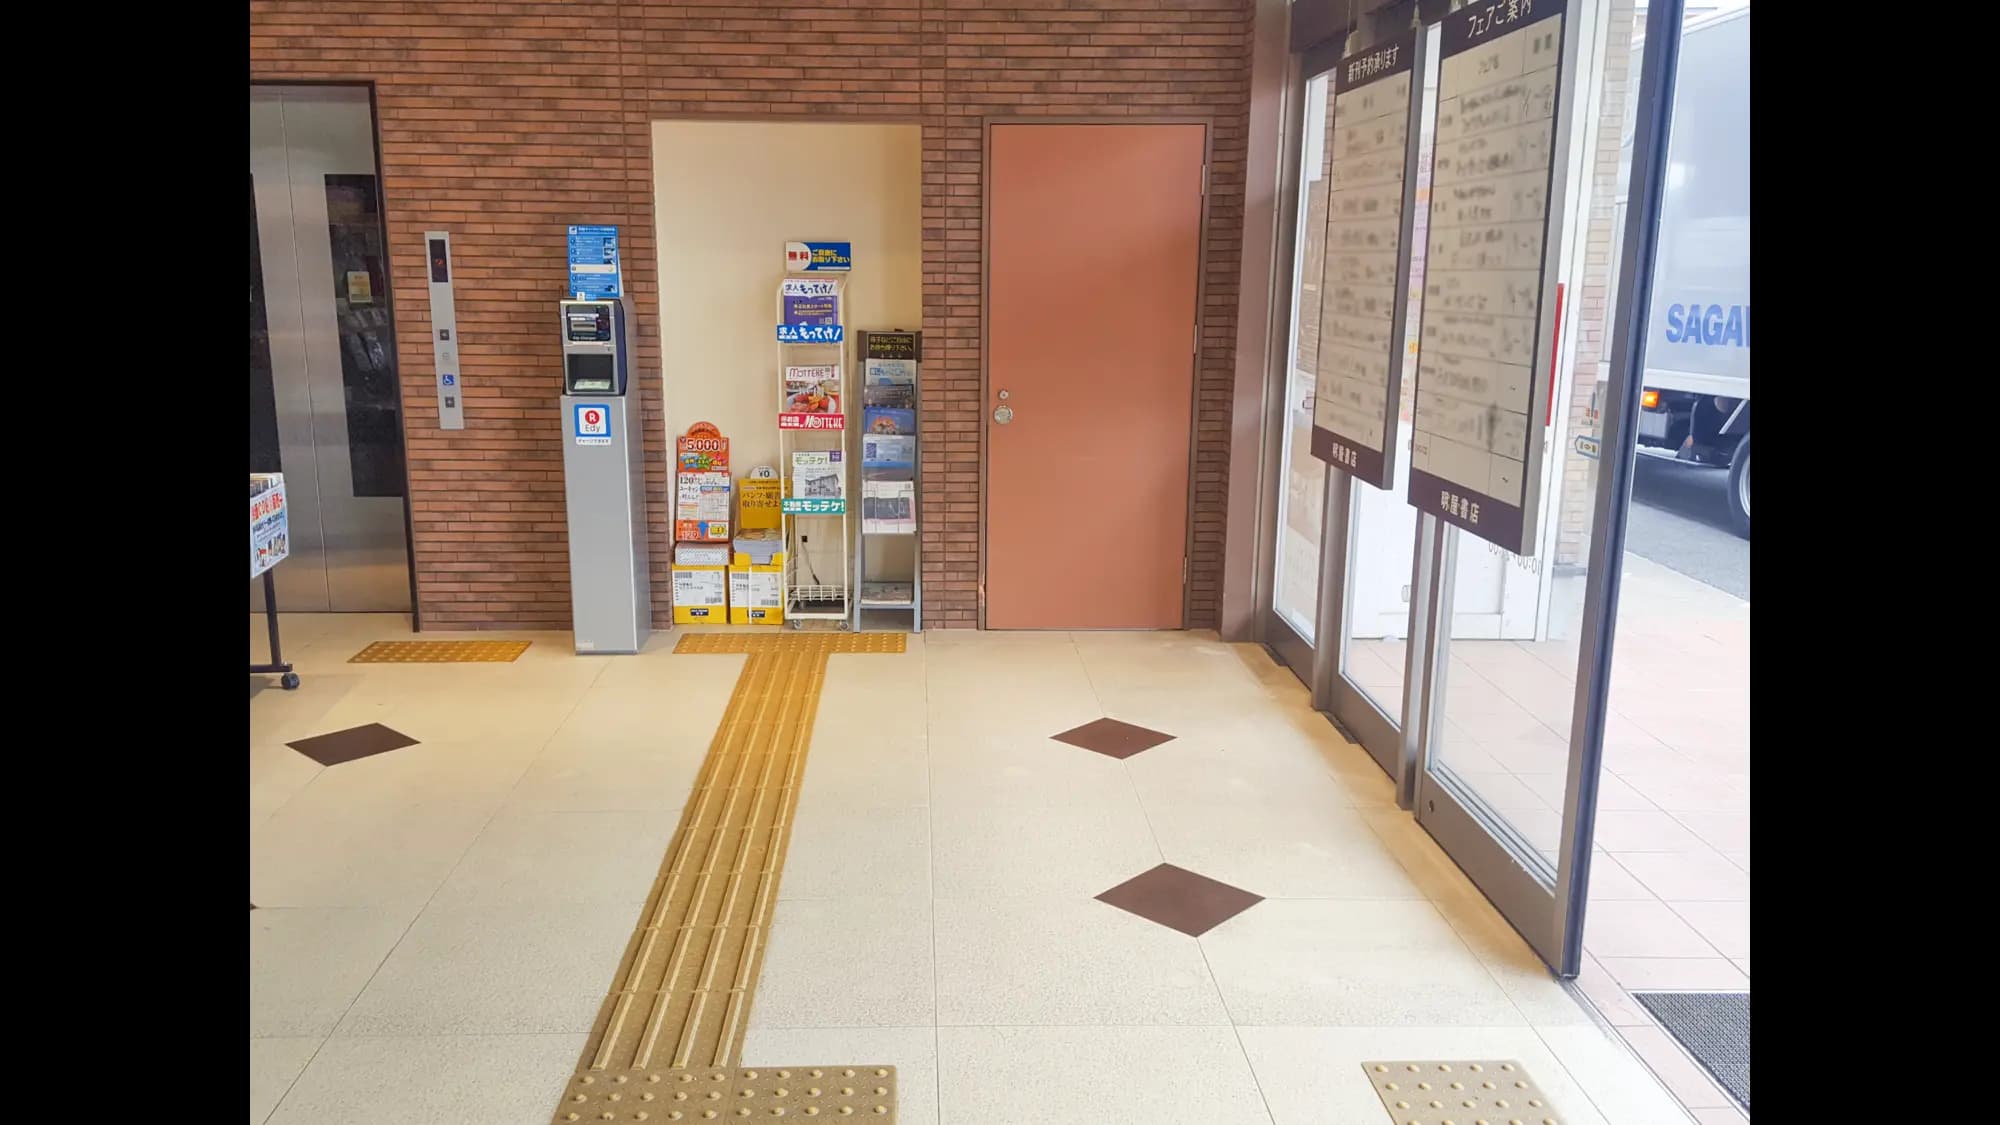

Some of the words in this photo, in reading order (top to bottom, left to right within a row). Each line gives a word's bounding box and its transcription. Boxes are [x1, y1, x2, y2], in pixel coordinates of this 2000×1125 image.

[1468, 0, 1532, 38] フェアご案内
[1347, 44, 1399, 83] 新刊予約承ります
[788, 251, 809, 261] 無料
[584, 424, 601, 432] Edy
